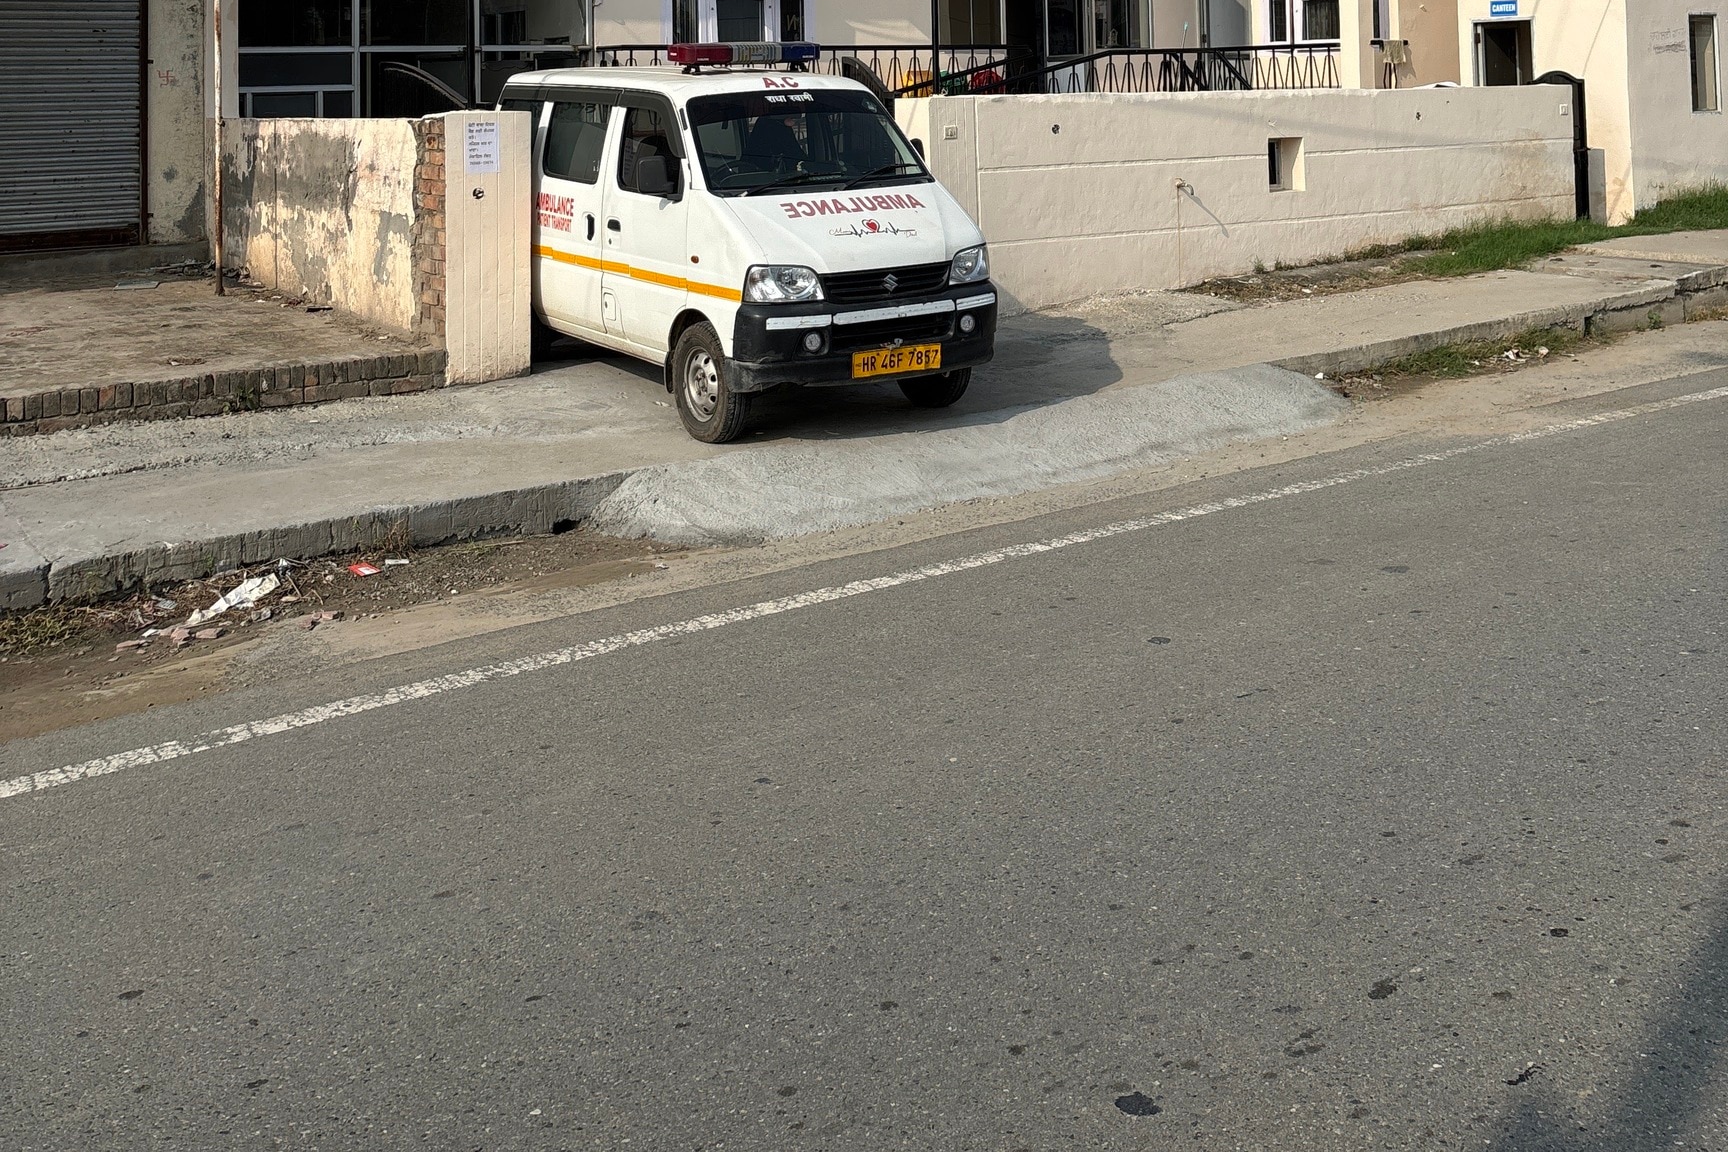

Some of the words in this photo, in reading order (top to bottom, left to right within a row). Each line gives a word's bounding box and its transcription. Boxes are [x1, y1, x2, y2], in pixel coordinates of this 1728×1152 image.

[1491, 3, 1516, 13] CANTEEN
[762, 76, 799, 88] A.C
[535, 191, 574, 217] AMBULANCE
[862, 355, 877, 373] HR
[881, 352, 904, 370] 46F
[908, 349, 939, 367] 7857
